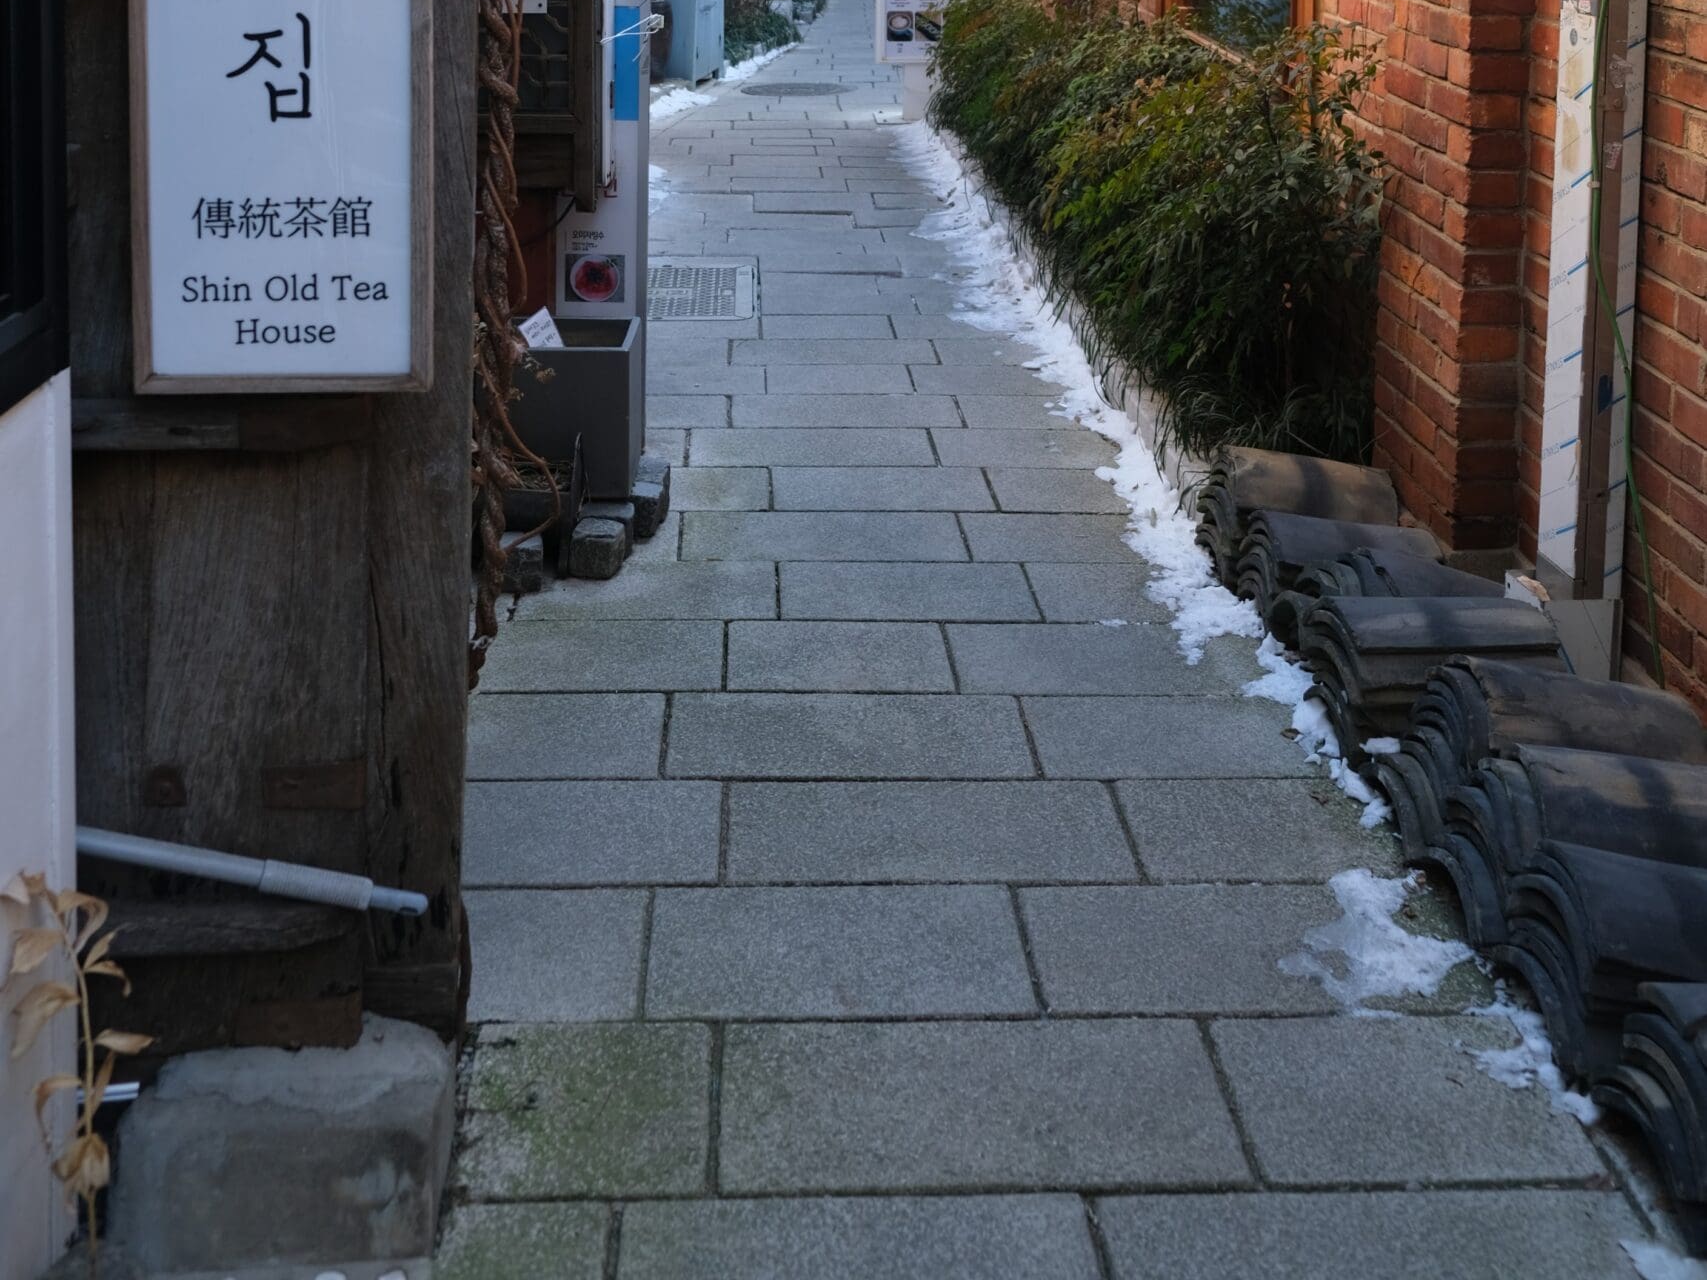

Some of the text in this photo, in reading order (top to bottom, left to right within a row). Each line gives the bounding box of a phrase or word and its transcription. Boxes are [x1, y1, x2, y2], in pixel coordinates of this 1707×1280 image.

[192, 195, 373, 240] 傳統茶館
[181, 273, 390, 303] Shin Old Tea
[235, 318, 336, 345] House
